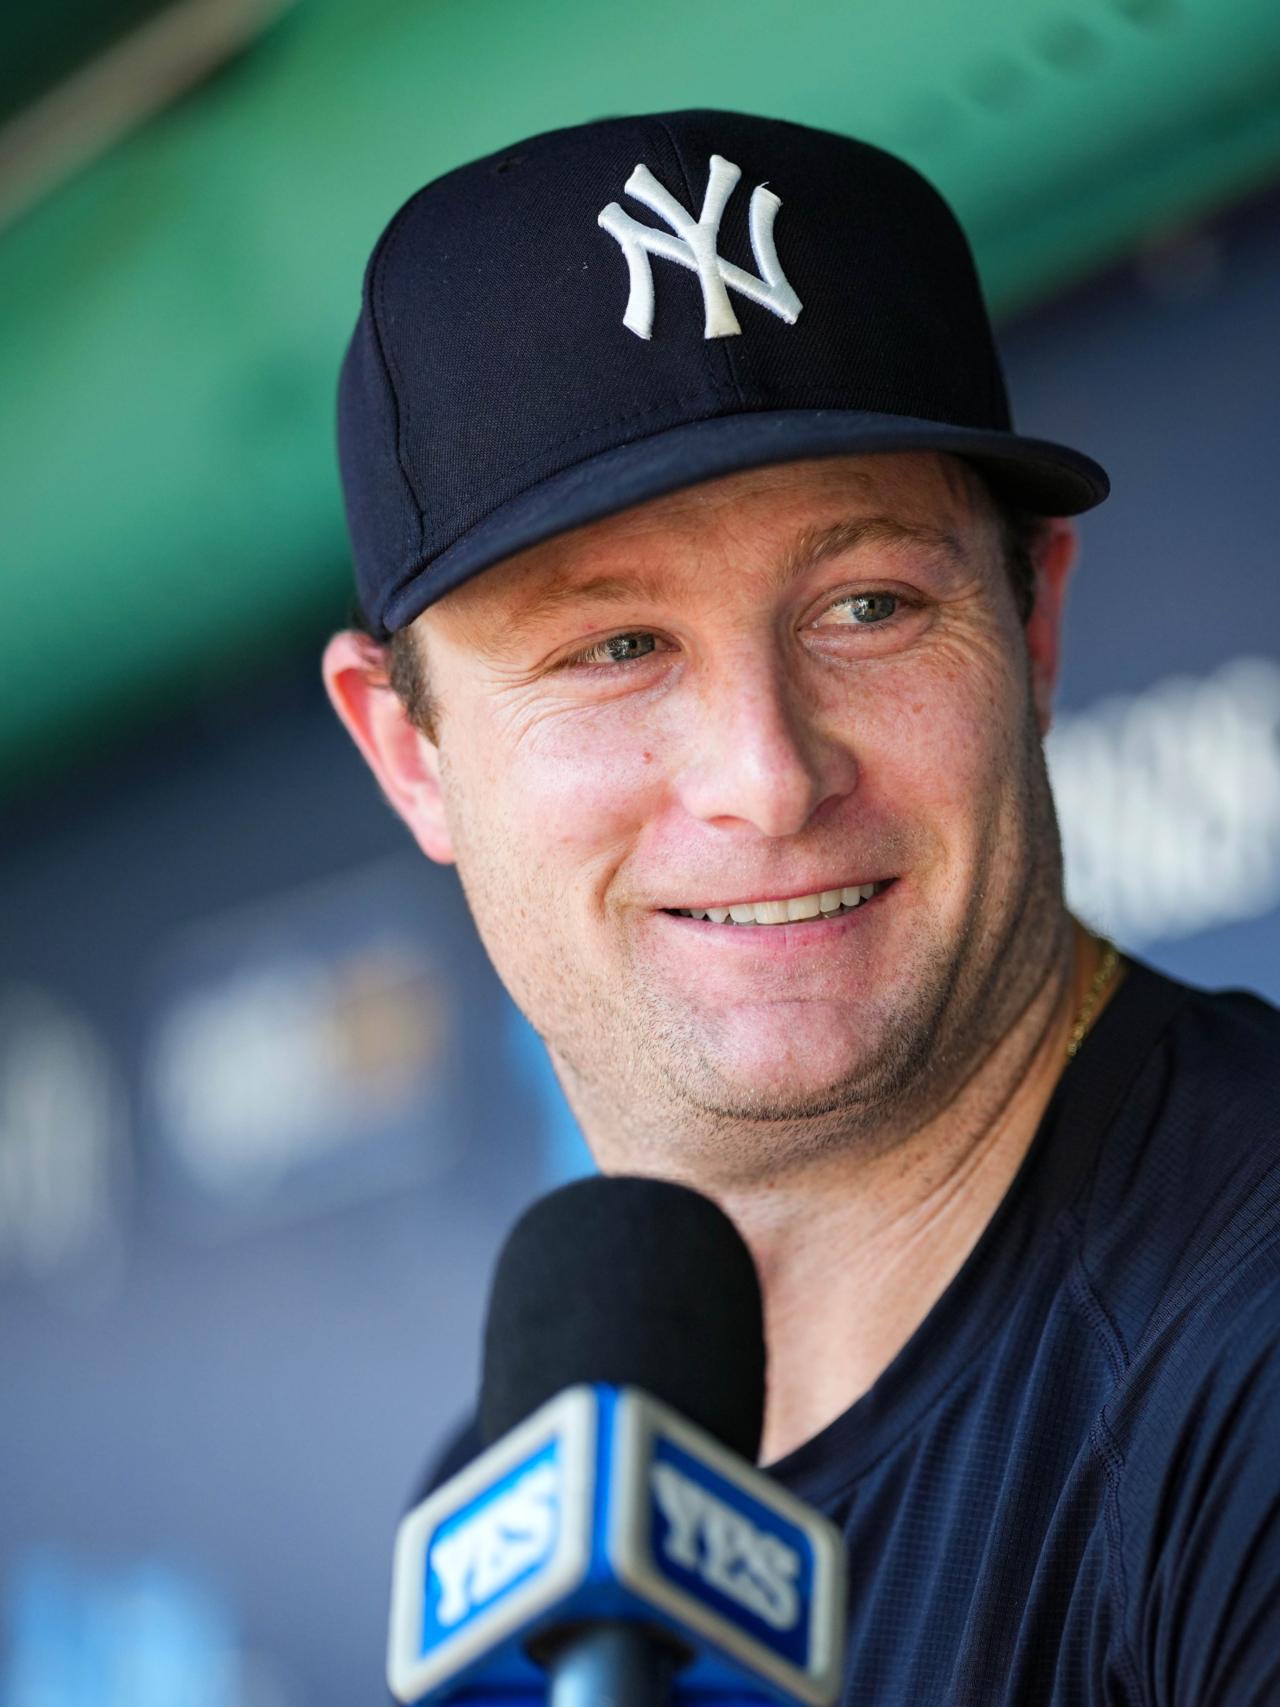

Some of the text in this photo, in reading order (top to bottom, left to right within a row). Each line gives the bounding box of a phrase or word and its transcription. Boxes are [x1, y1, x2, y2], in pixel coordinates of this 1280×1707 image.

[598, 154, 803, 340] NY
[430, 1458, 559, 1628] YES
[653, 1464, 800, 1632] YES
